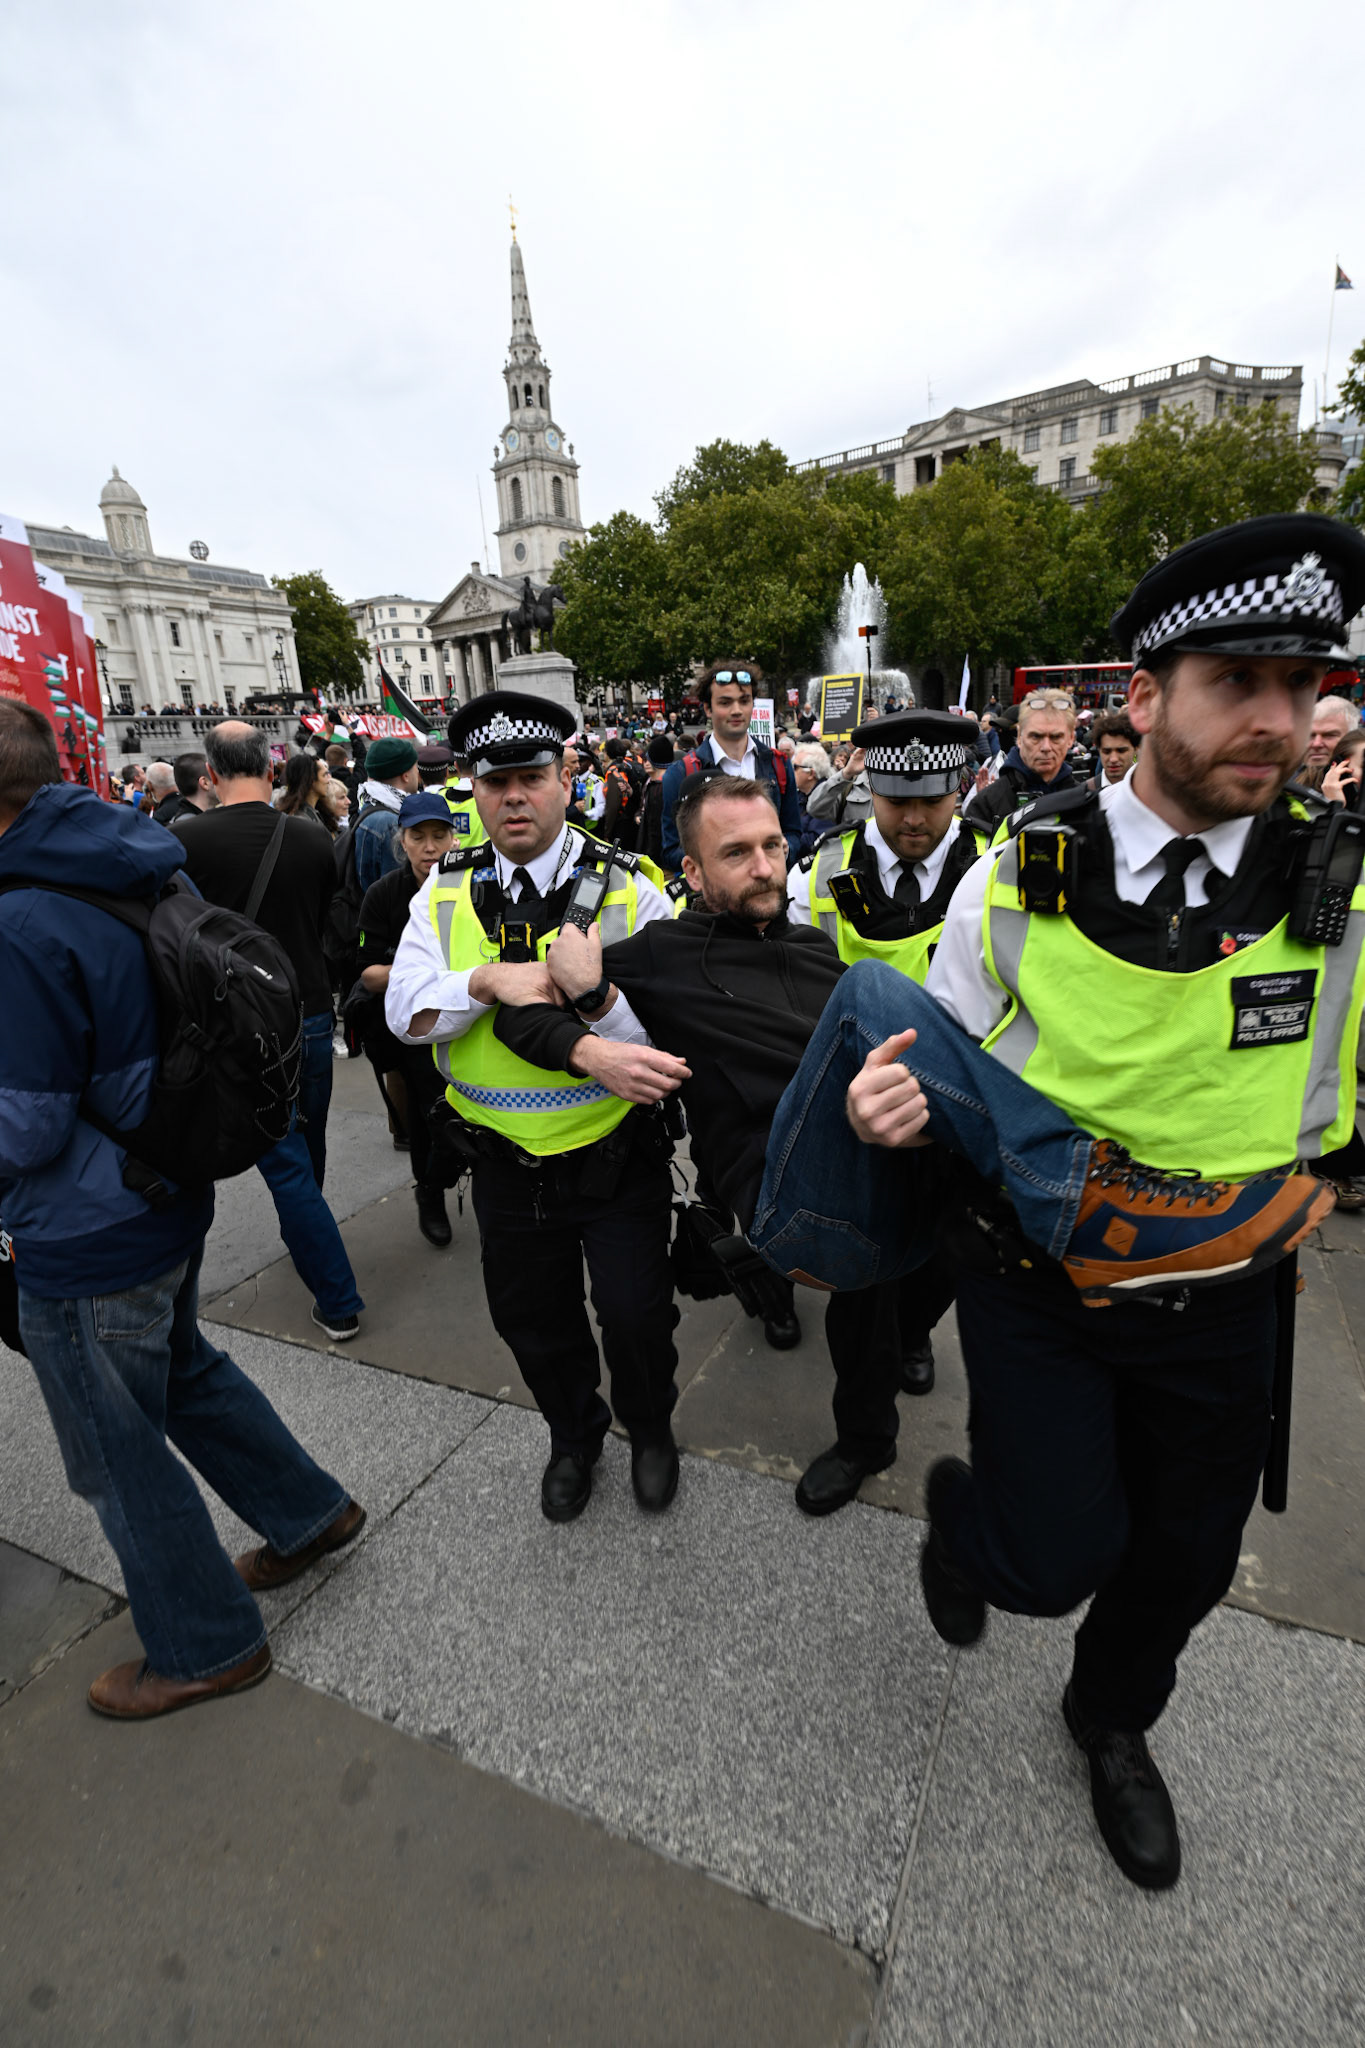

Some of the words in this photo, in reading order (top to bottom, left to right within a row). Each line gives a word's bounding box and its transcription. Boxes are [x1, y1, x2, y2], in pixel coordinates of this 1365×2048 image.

[759, 709, 770, 719] BAN
[760, 721, 770, 734] THE
[1270, 1012, 1299, 1024] POLICE
[1237, 1030, 1271, 1042] POLICE
[1271, 1024, 1305, 1038] OFFICER
